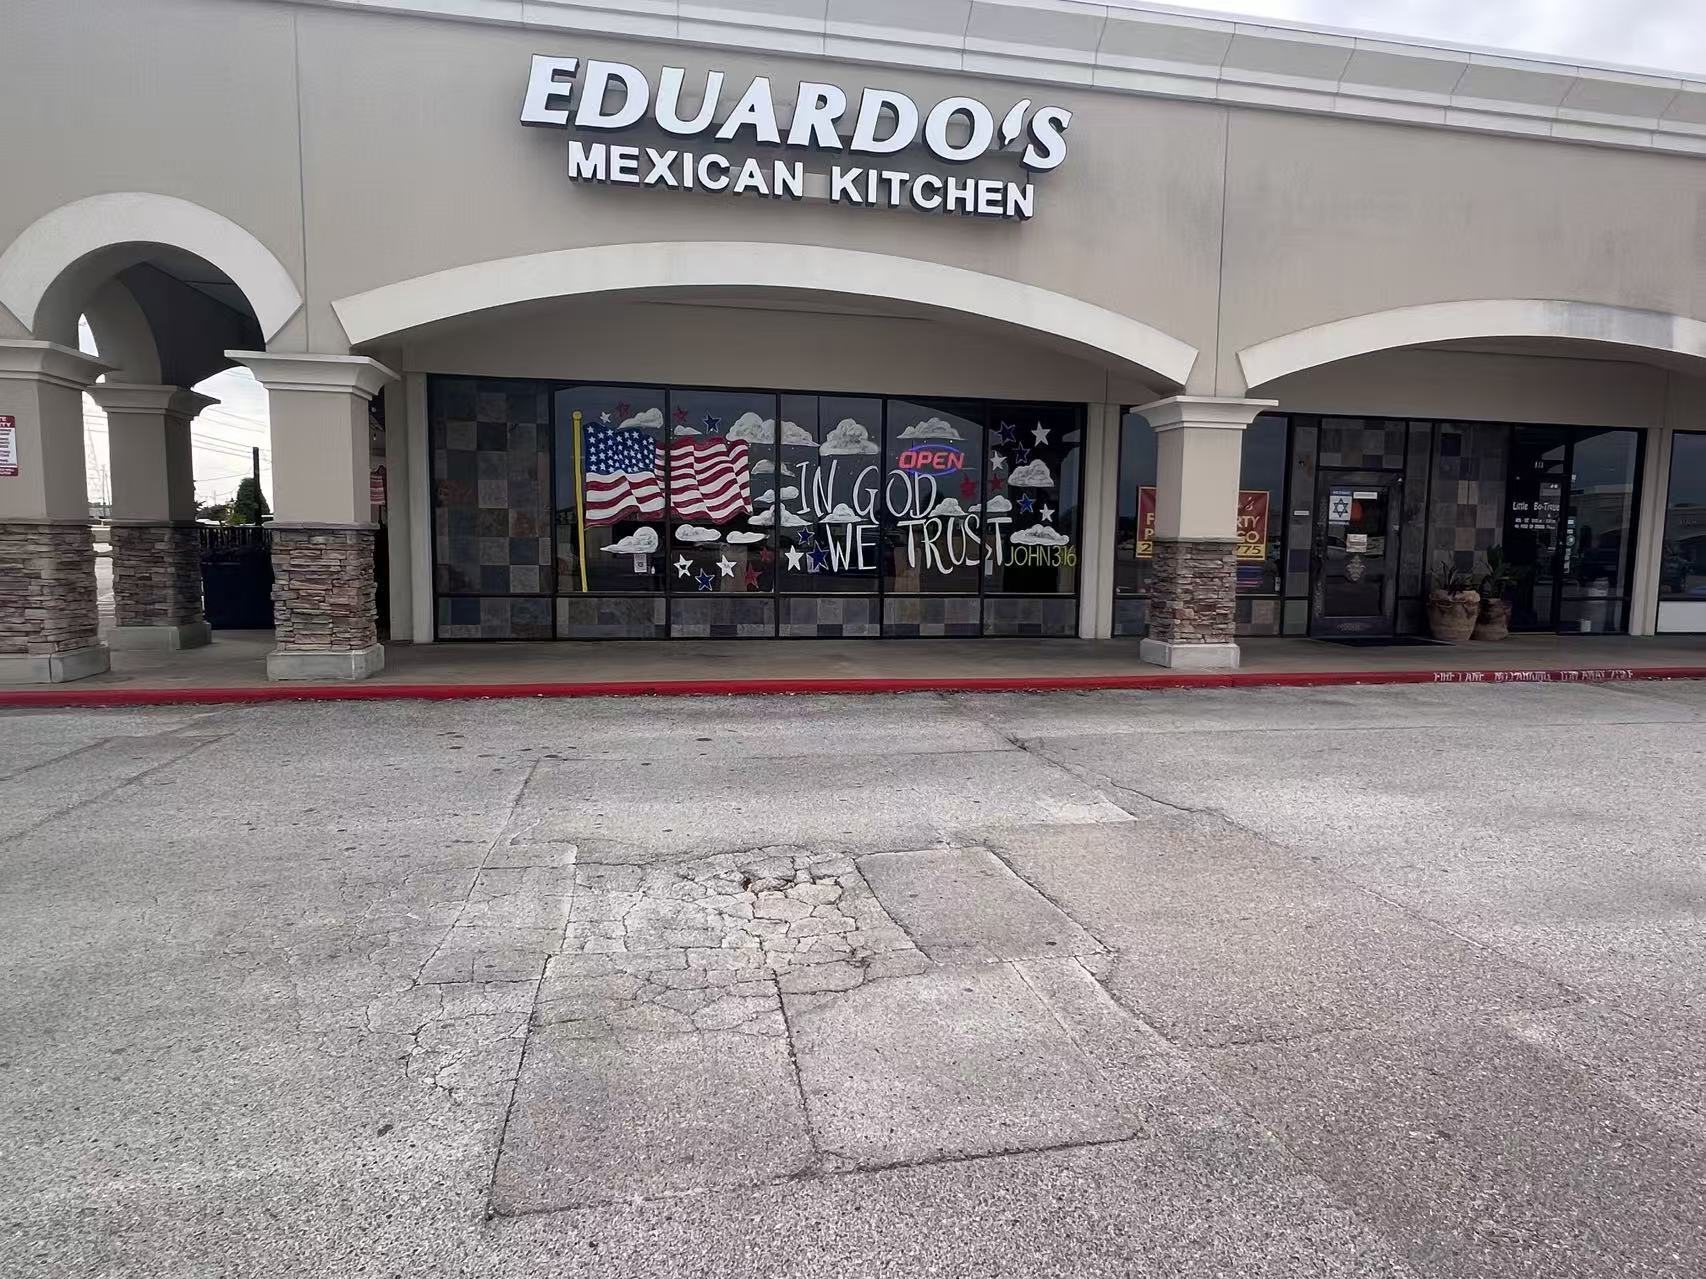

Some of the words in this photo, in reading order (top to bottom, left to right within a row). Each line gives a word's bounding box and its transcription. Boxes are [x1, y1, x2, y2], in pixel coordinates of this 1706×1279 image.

[519, 53, 1074, 170] EDUARDO'S
[567, 140, 804, 199] MEXICAN
[831, 164, 1035, 219] KITCHEN
[898, 450, 966, 470] OPEN
[796, 459, 838, 518] IN
[853, 465, 937, 525] GOD
[826, 522, 880, 573] WE
[896, 514, 1013, 574] TRUST
[1004, 545, 1051, 567] JOHN
